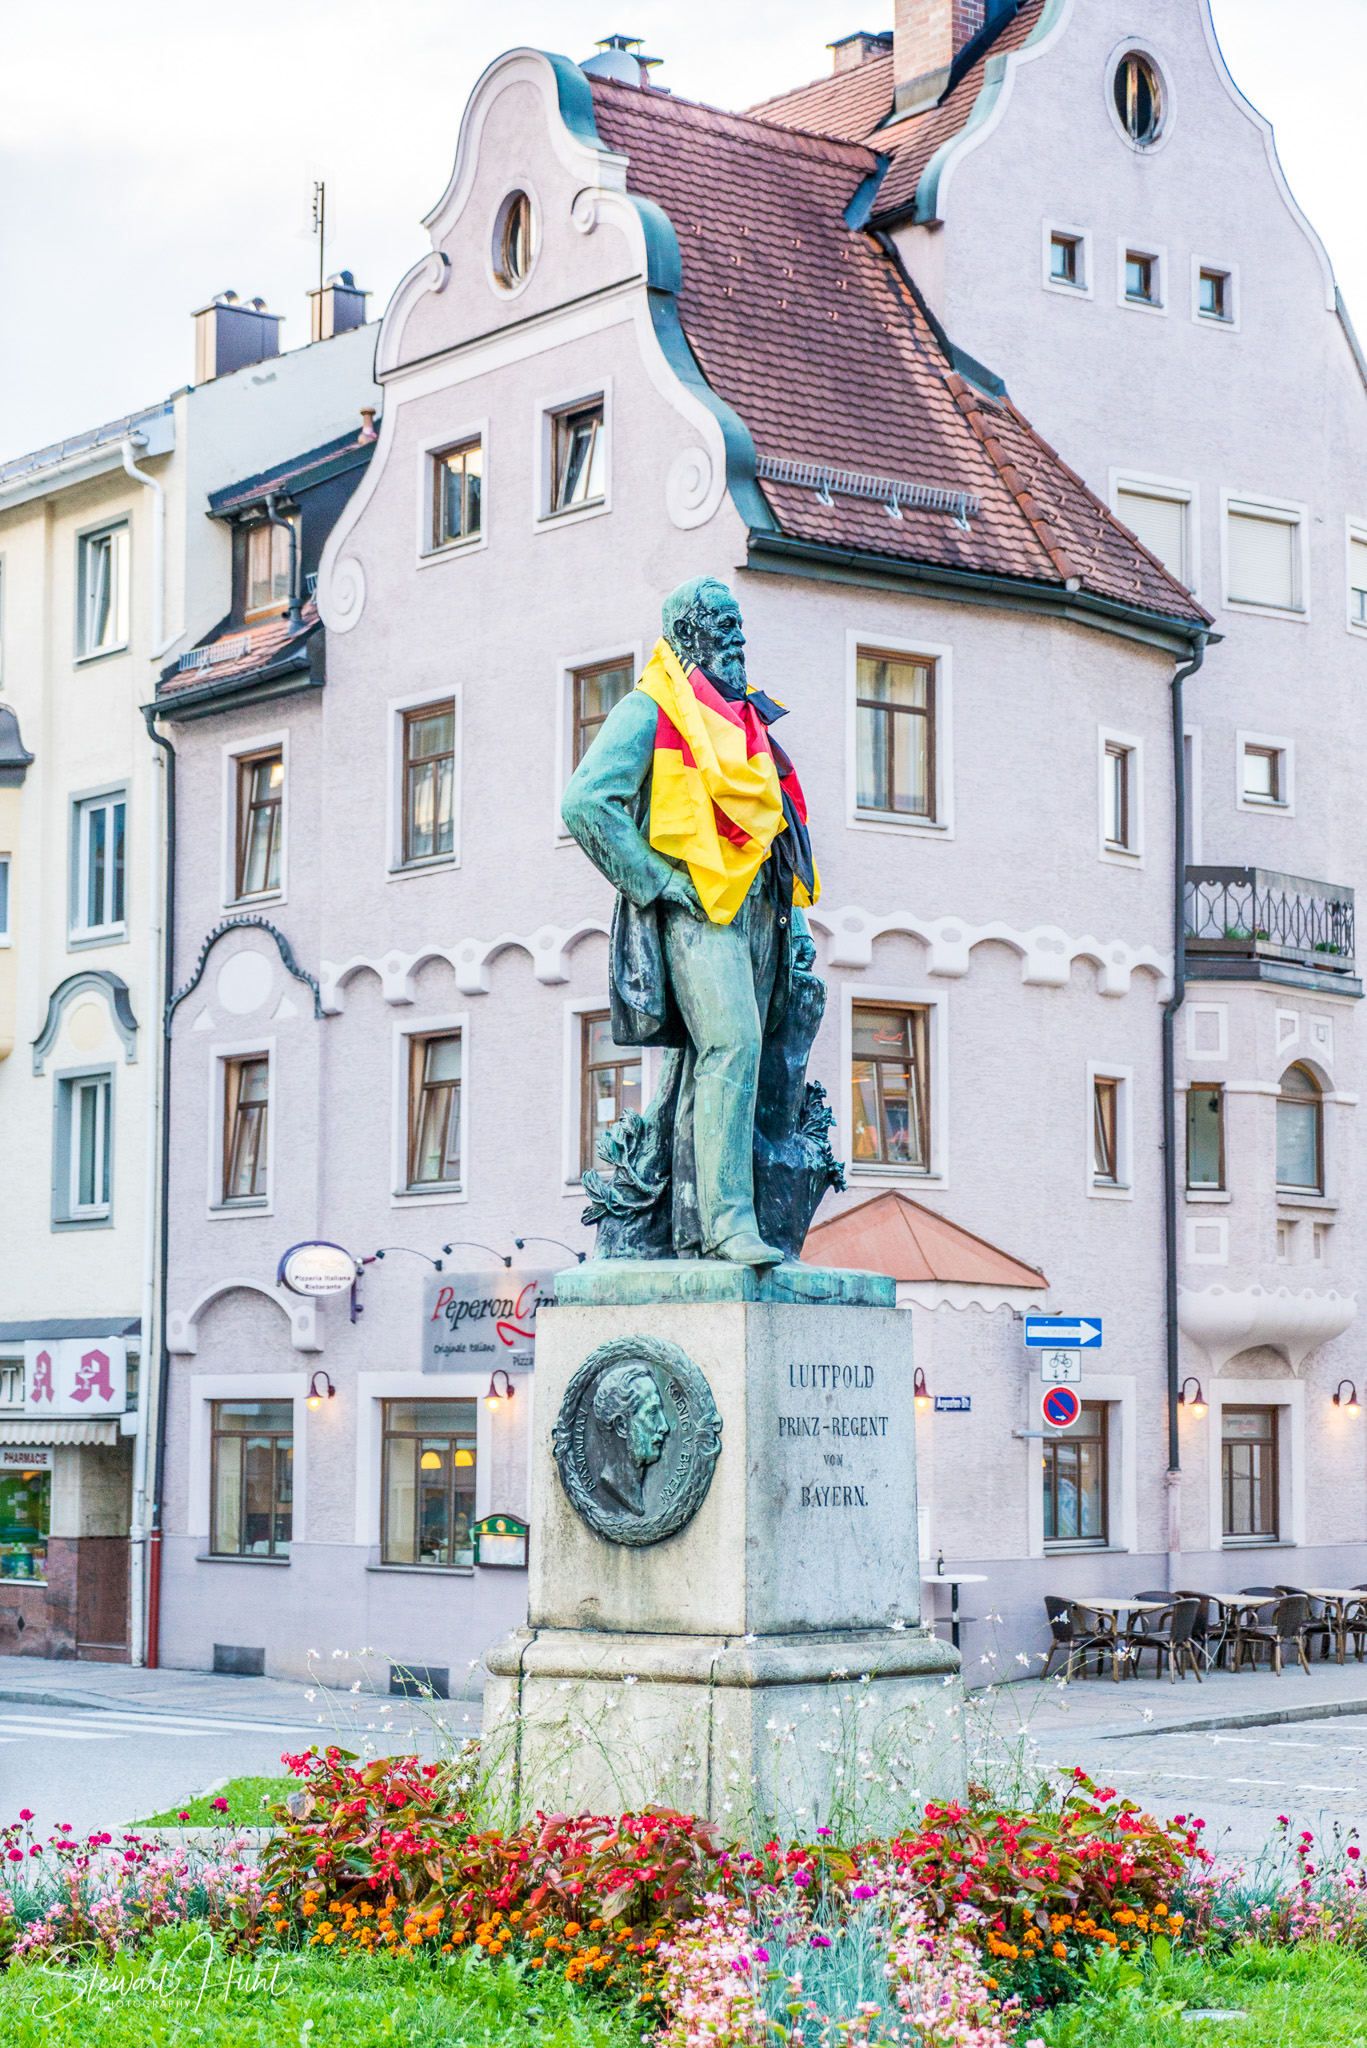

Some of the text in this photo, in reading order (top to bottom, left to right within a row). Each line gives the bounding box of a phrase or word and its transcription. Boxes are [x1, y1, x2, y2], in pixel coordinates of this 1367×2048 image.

[430, 1280, 555, 1331] PeperonCin
[789, 1364, 875, 1388] LUITPOLD
[665, 1381, 692, 1432] KOENIG
[4, 1452, 48, 1464] PHARMACIE
[575, 1407, 597, 1493] MAXIMILIAN
[823, 1454, 844, 1467] VON
[659, 1452, 690, 1505] BAYERN
[801, 1485, 869, 1508] BAYERN.
